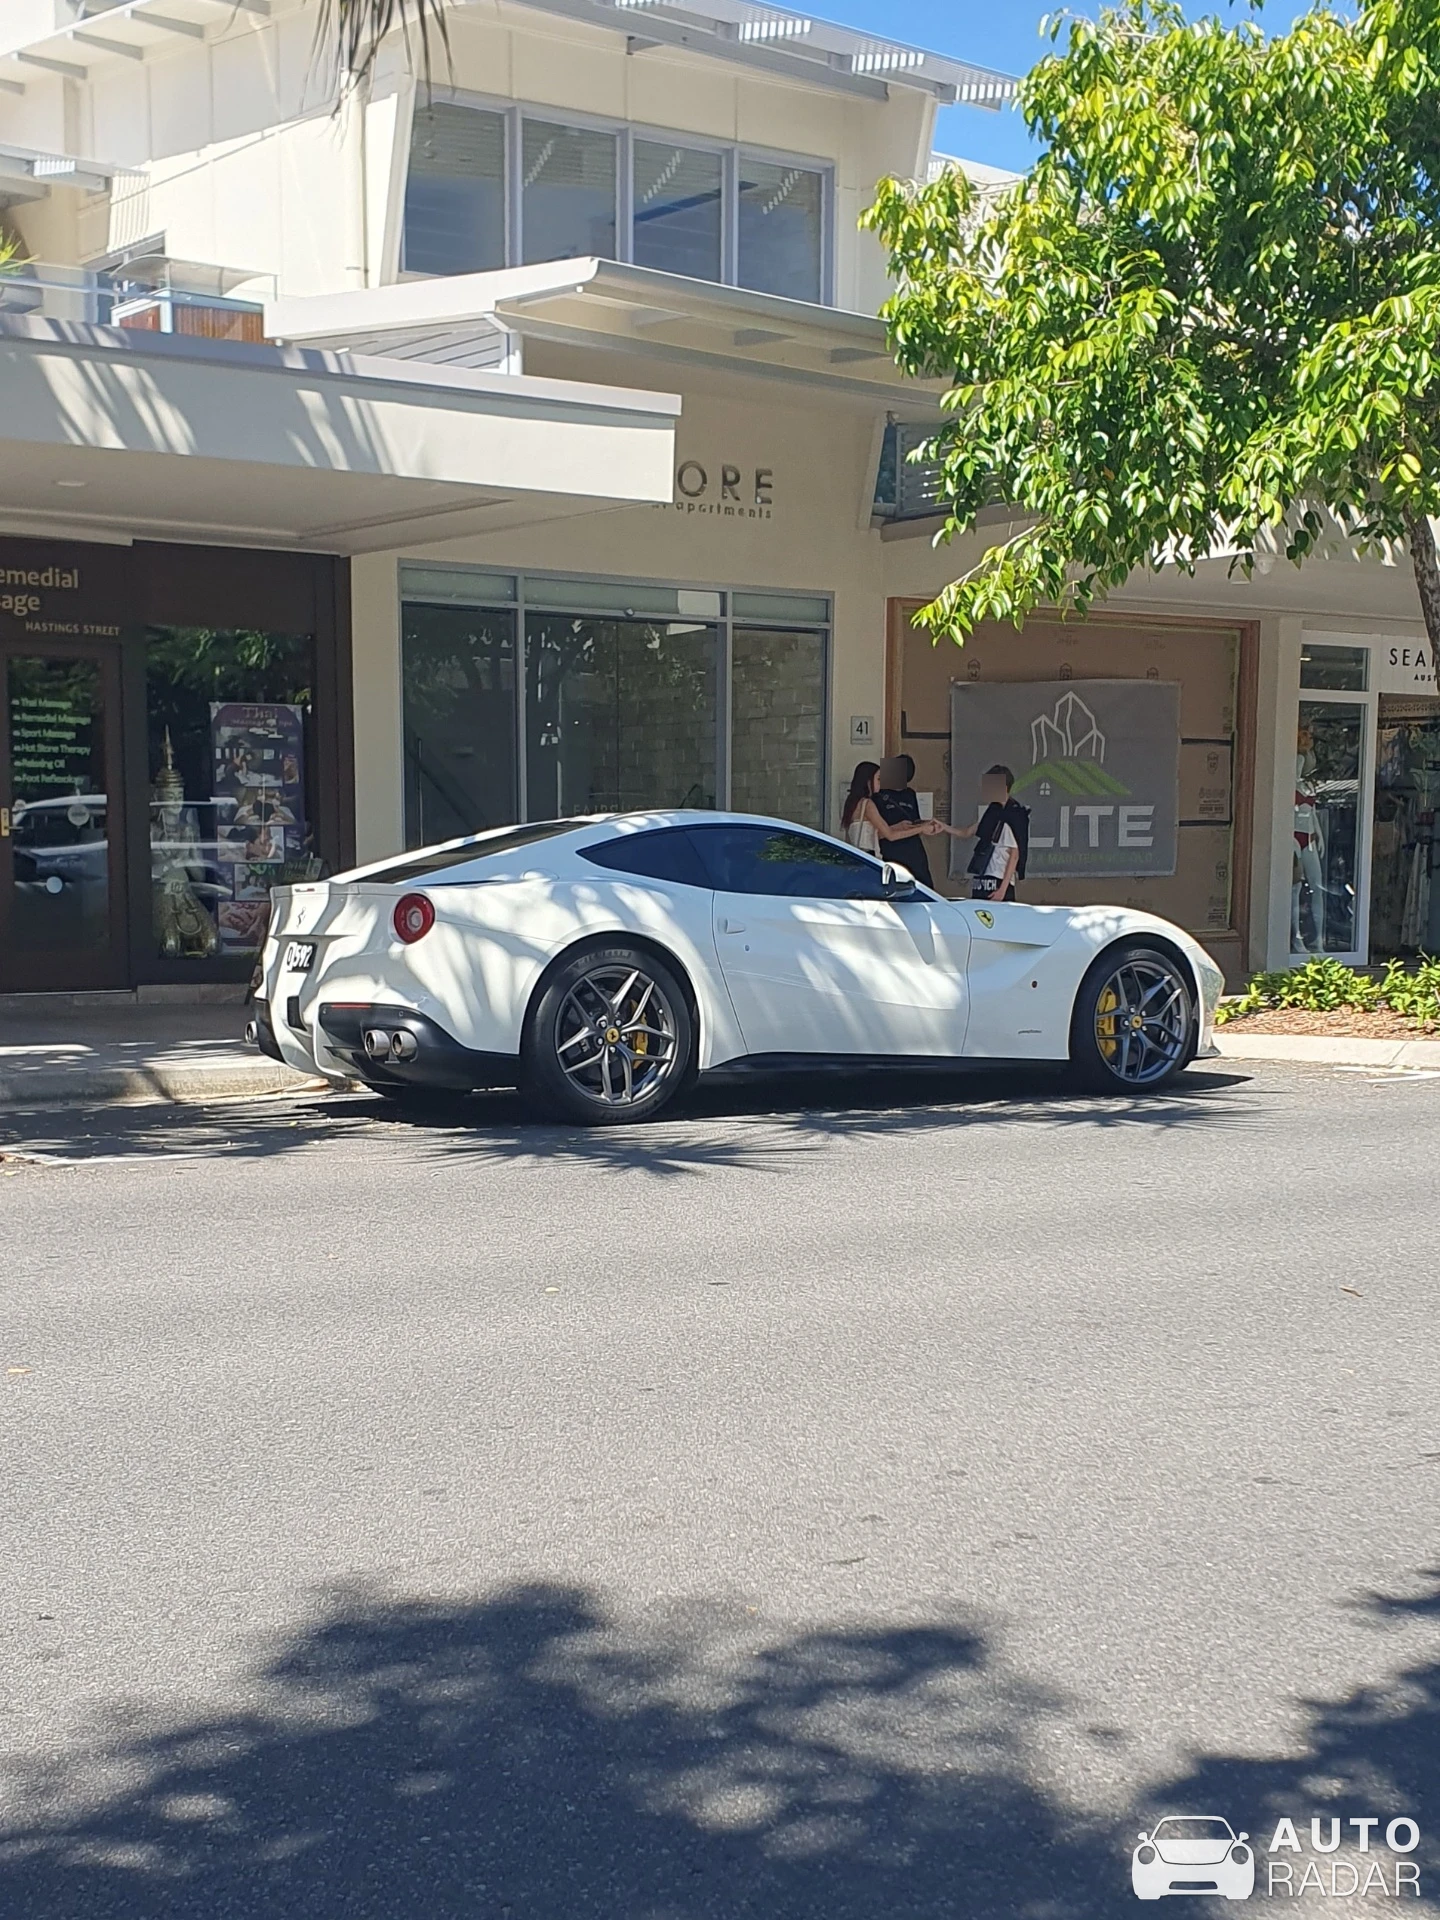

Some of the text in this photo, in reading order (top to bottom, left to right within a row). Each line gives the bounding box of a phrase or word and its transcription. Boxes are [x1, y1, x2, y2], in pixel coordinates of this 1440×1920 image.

[675, 501, 772, 519] apartments
[0, 593, 41, 616] age
[25, 621, 121, 637] HASTINGS STREET
[856, 721, 869, 735] 41
[978, 805, 1155, 848] LITE
